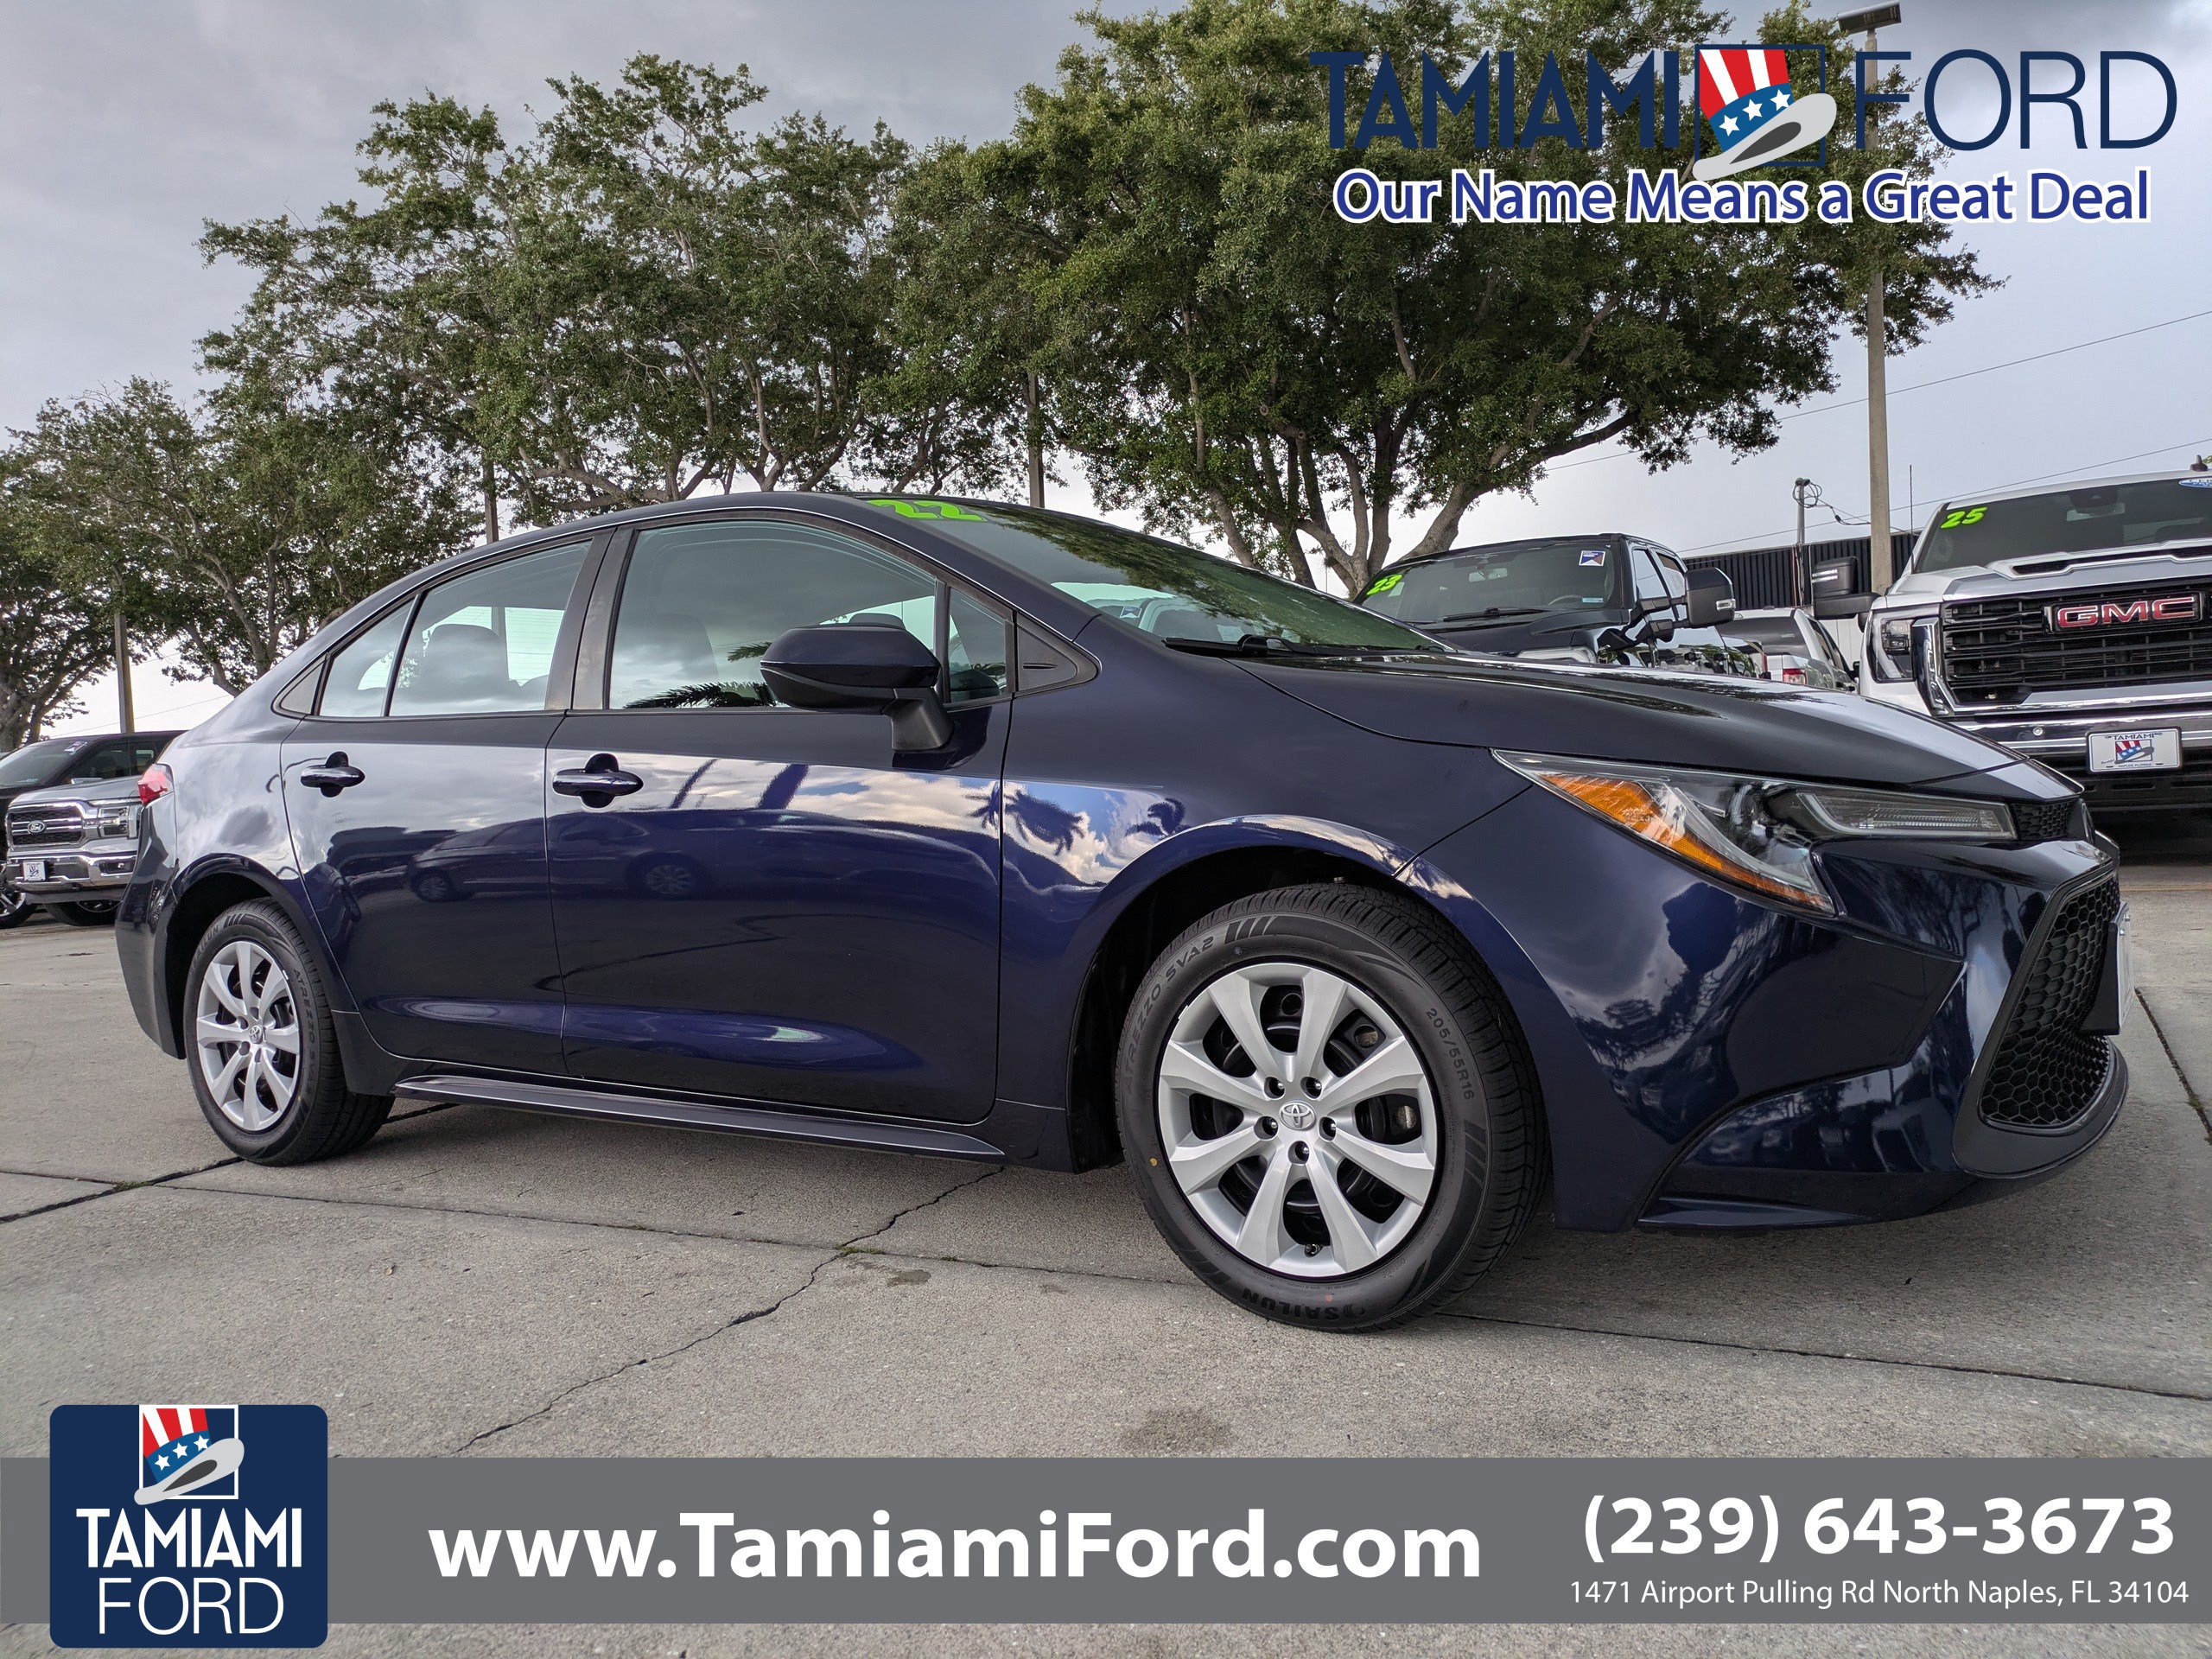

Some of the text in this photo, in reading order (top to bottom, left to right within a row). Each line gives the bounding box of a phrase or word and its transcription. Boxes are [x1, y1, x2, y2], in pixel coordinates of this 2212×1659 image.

[867, 500, 988, 522] 22
[1941, 507, 1987, 529] 25
[1366, 574, 1402, 595] 23
[2057, 597, 2195, 627] GMC
[1425, 1007, 1475, 1100] 205/55R16
[1241, 1291, 1340, 1322] SAILUN
